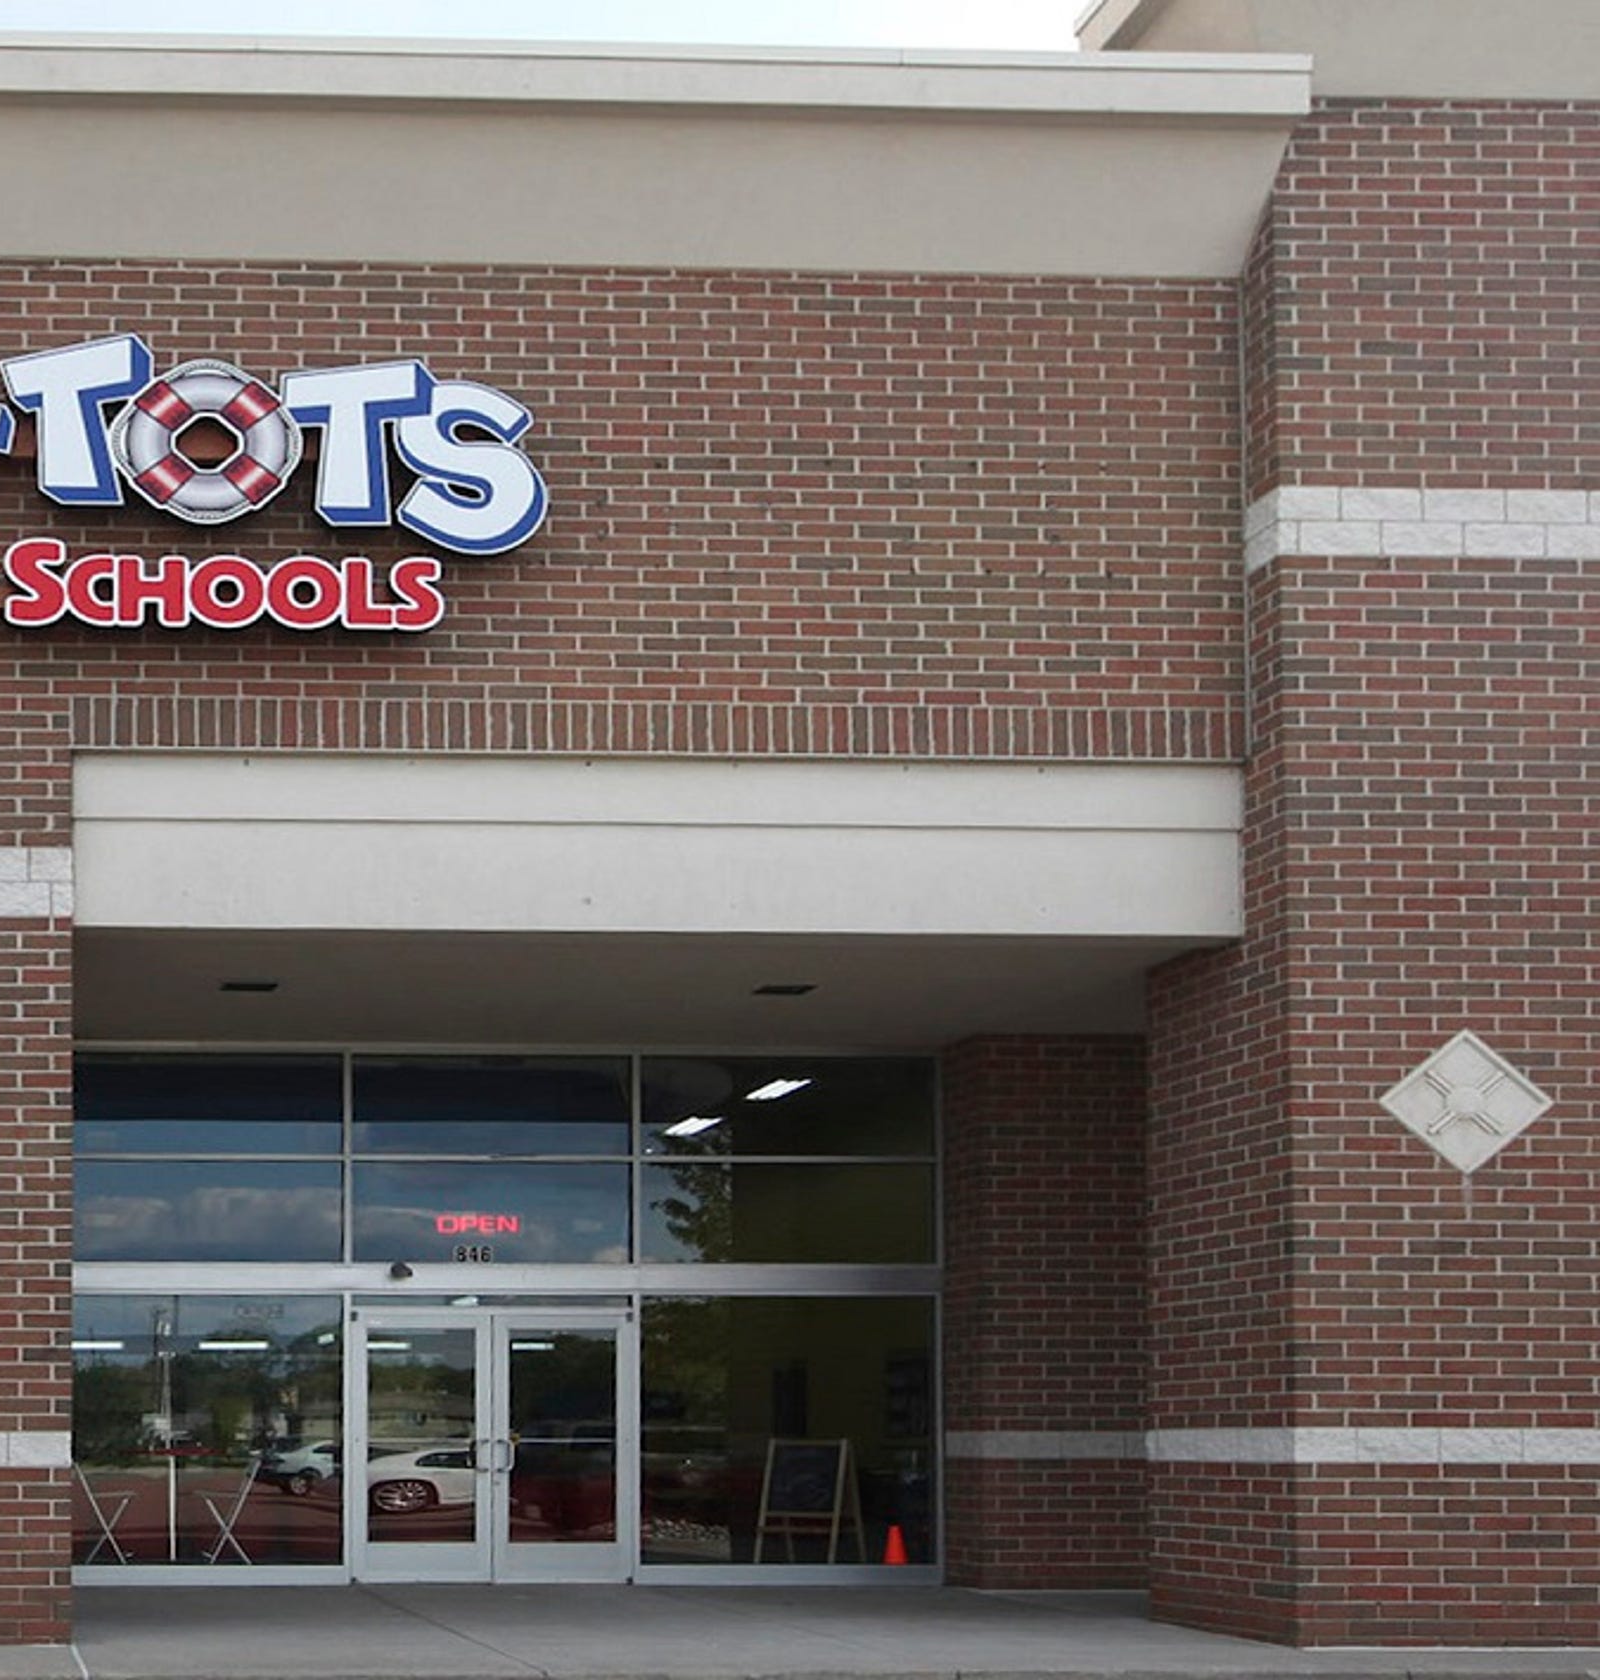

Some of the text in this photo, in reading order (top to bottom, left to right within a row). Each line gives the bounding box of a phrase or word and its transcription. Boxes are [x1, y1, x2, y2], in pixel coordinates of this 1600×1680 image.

[4, 538, 444, 630] SCHOOLS
[436, 1214, 520, 1235] OPEN
[456, 1246, 492, 1263] 846
